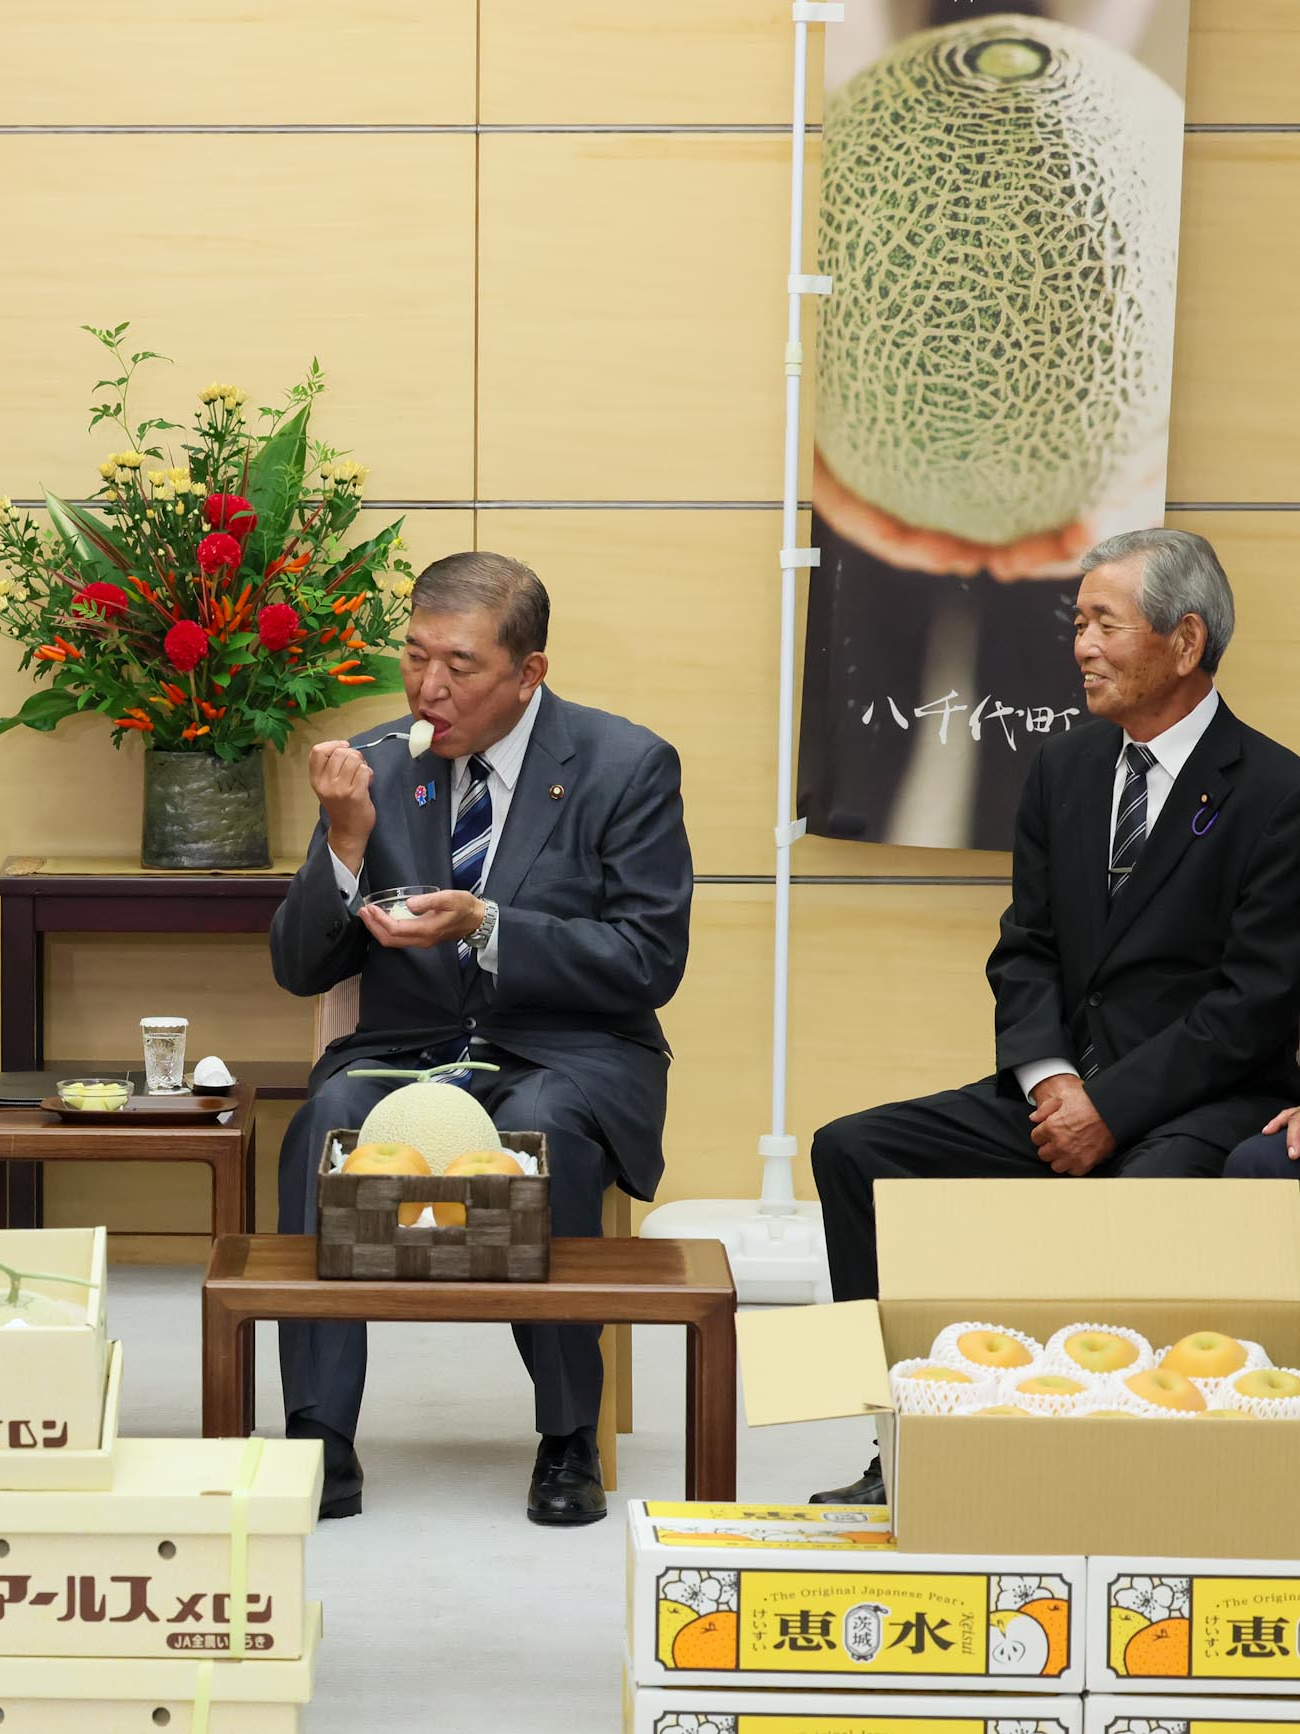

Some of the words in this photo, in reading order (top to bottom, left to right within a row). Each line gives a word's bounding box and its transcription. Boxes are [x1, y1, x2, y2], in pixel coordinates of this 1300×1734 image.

[861, 689, 1081, 752] 八千代町
[770, 1591, 796, 1603] The
[800, 1585, 857, 1599] Original
[860, 1586, 923, 1599] Japanese
[927, 1591, 958, 1606] Pear
[1222, 1597, 1248, 1608] The
[173, 1634, 266, 1649] JA全農いらき
[752, 1607, 768, 1652] けいすい
[773, 1609, 837, 1652] 恵
[886, 1611, 957, 1655] 水
[852, 1615, 873, 1649] 茨城
[958, 1611, 976, 1655] Keisui
[1204, 1615, 1220, 1658] けいすい
[1225, 1615, 1291, 1659] 恵
